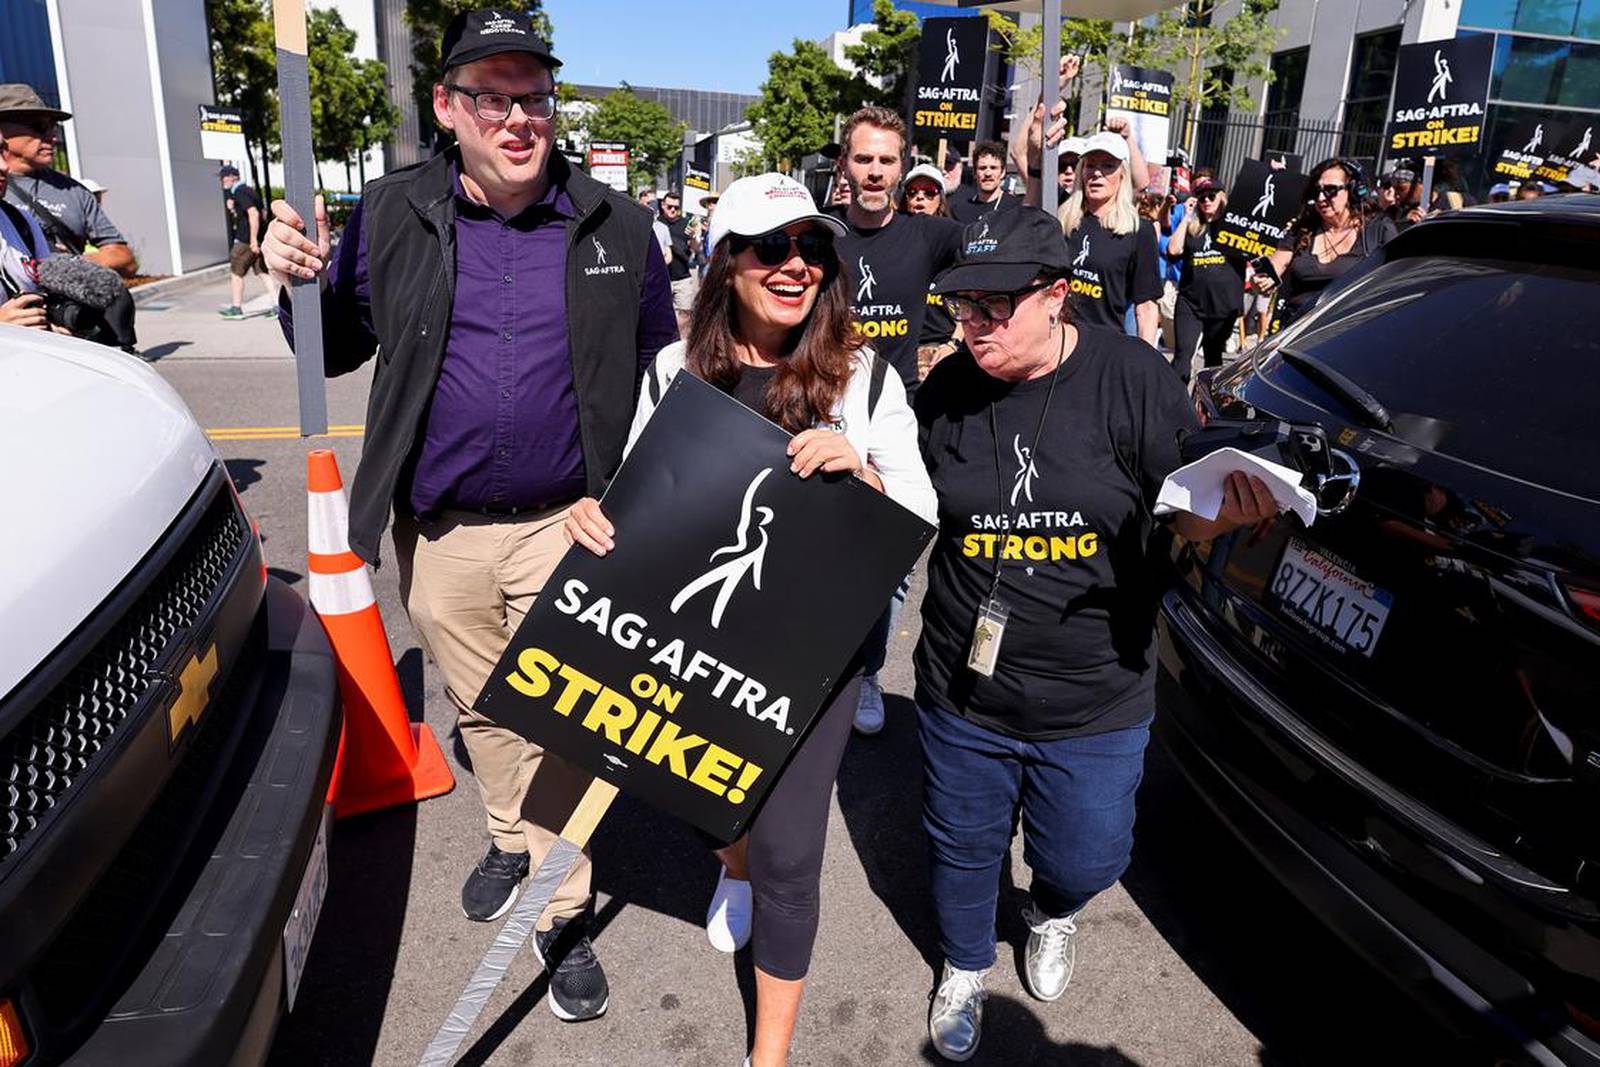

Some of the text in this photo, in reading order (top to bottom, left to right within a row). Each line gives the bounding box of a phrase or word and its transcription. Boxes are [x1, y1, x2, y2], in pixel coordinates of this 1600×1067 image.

[939, 101, 953, 111] ON
[1110, 95, 1168, 115] STRIKE!
[914, 110, 977, 130] STRIKE!
[1426, 120, 1444, 130] ON
[1391, 126, 1480, 149] STRIKE!
[1216, 230, 1277, 257] STRIKE
[1245, 231, 1260, 240] ON
[966, 244, 997, 254] STAFF
[1193, 256, 1225, 266] TRONG
[962, 532, 1099, 561] STRONG
[1303, 550, 1373, 599] California
[1274, 562, 1380, 651] 8ZZK175
[630, 672, 684, 714] ON
[505, 647, 764, 805] STRIKE!
